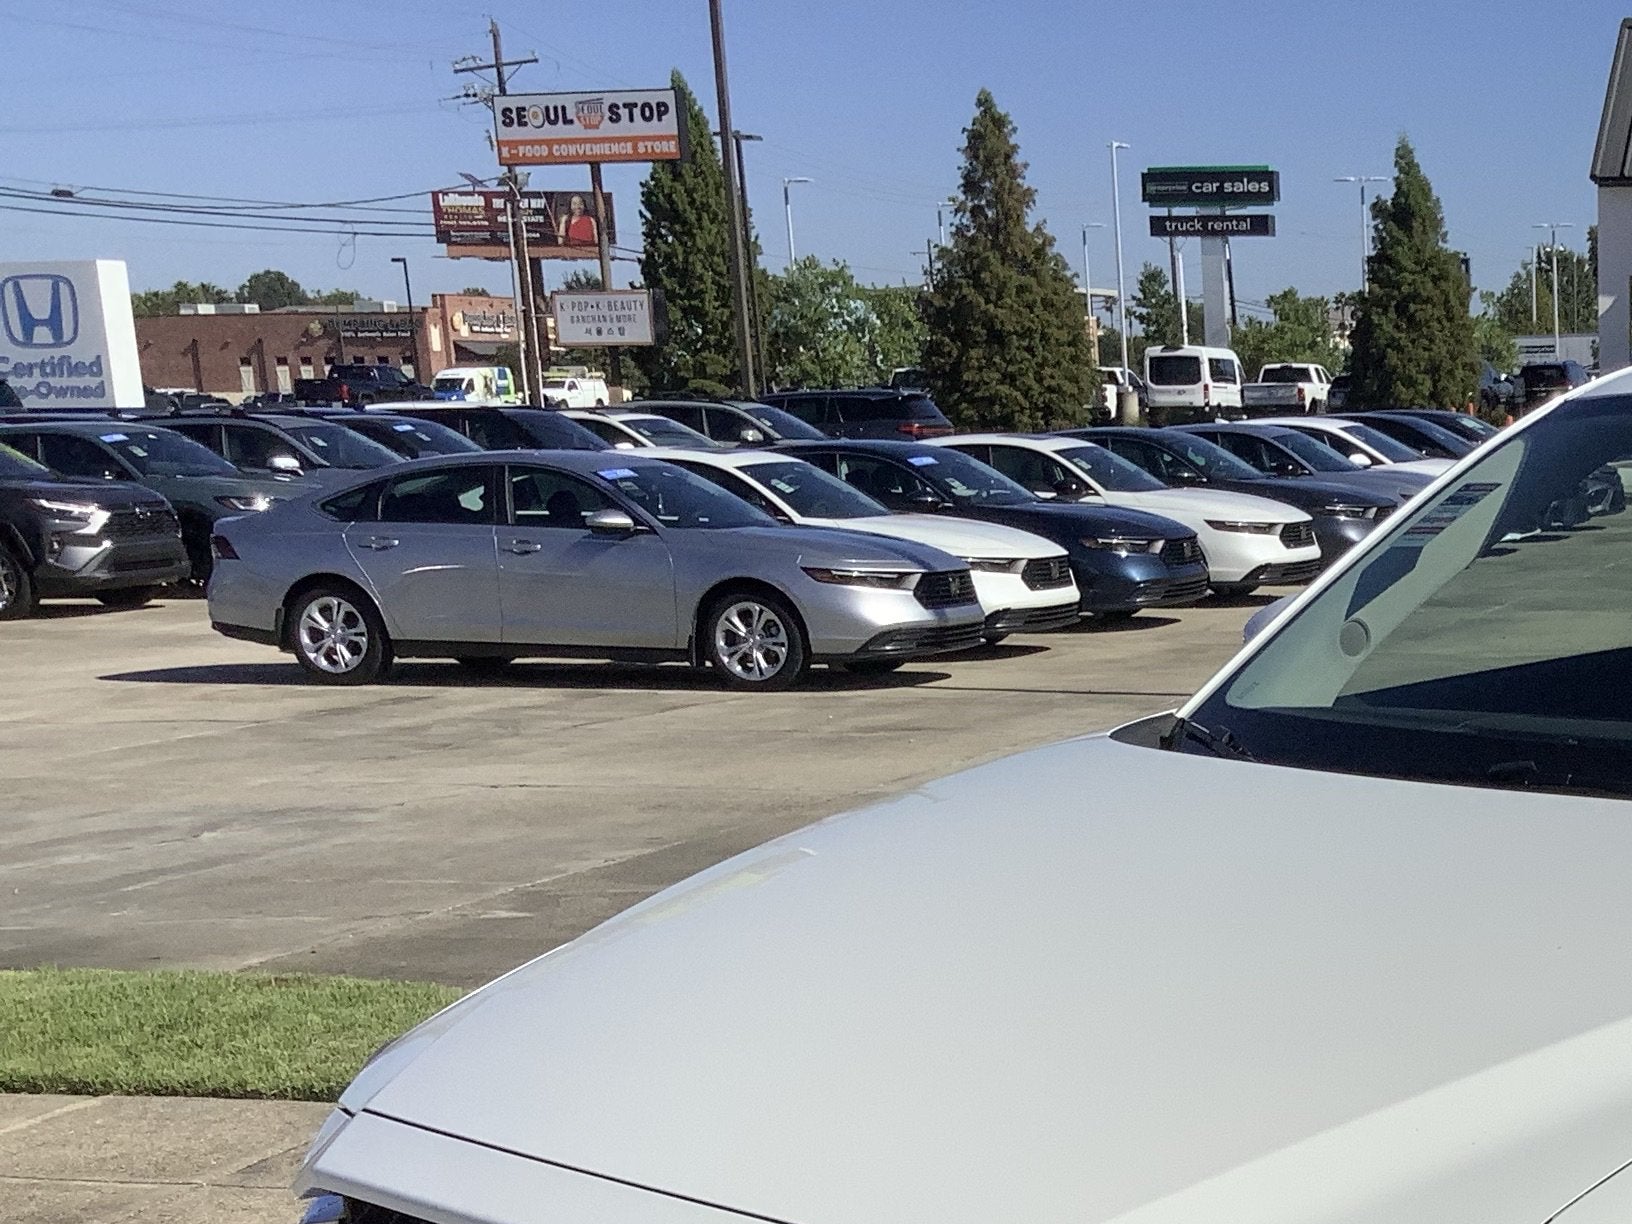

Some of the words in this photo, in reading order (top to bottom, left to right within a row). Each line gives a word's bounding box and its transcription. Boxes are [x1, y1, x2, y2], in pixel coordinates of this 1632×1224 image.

[501, 104, 574, 129] SEOUL
[607, 102, 670, 123] STOP
[501, 145, 548, 158] K-FOOD
[552, 142, 633, 156] CONVENIENCE
[637, 140, 677, 154] STORE
[1191, 181, 1221, 193] car
[1223, 177, 1270, 193] sales
[442, 206, 485, 214] THOMAS
[1165, 218, 1204, 231] truck
[1207, 218, 1251, 231] rental
[14, 380, 105, 399] e-Owned
